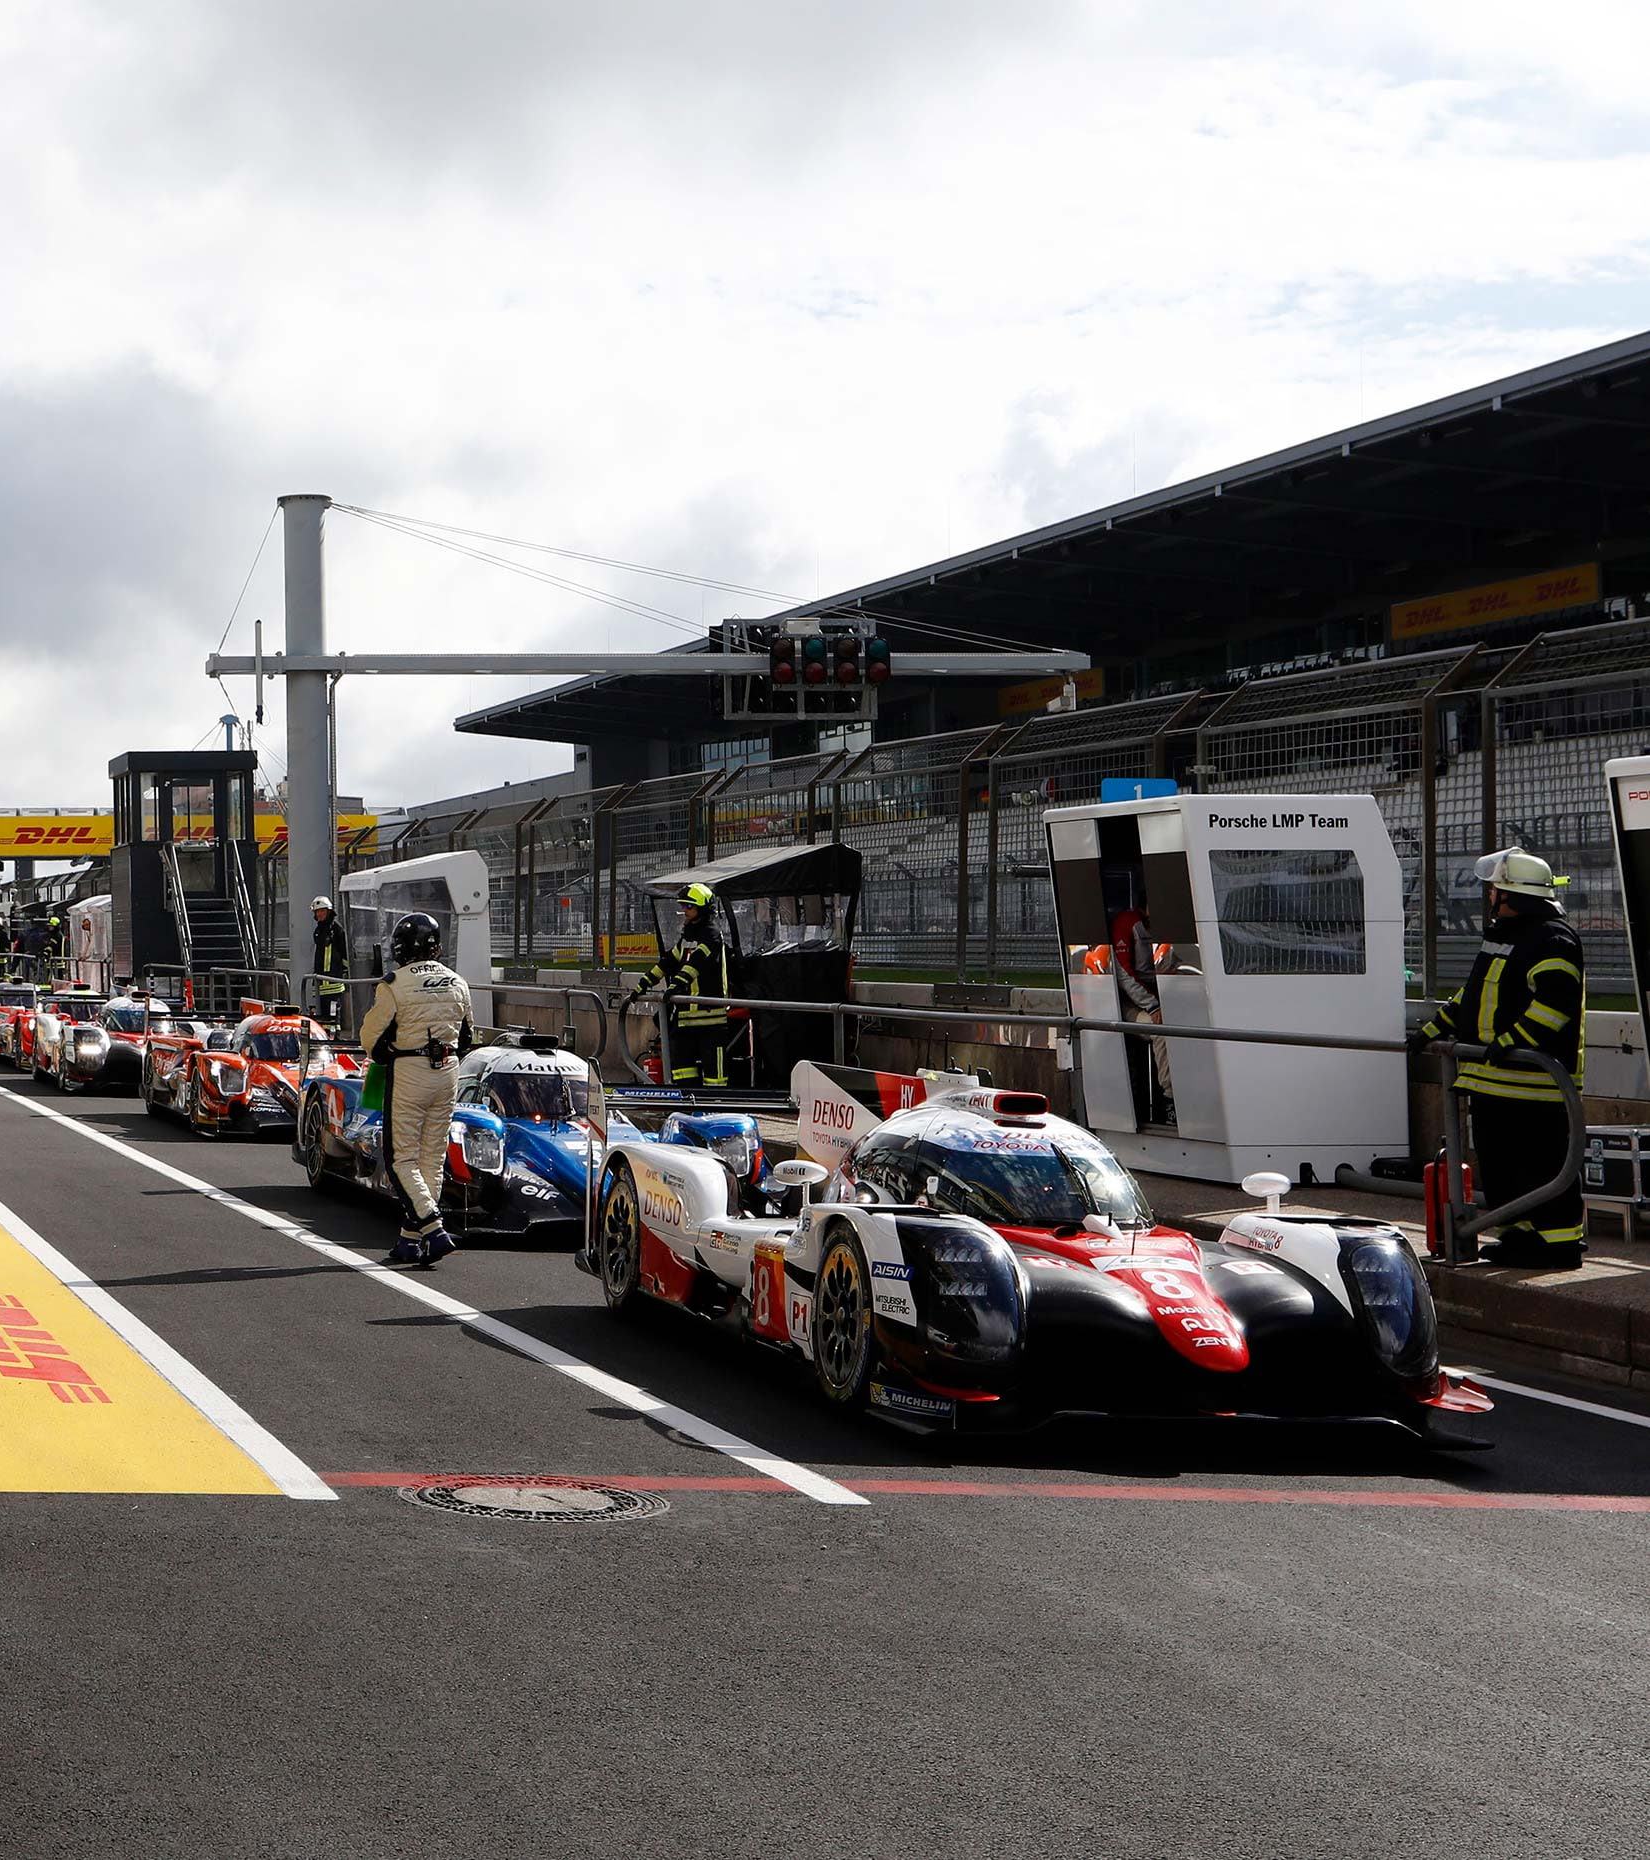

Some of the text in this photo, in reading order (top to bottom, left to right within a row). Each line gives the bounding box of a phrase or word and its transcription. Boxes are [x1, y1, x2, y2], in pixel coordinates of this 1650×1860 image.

[1534, 576, 1582, 601] DHL
[1468, 592, 1513, 615] DHL
[1405, 605, 1447, 628] DHL
[1133, 784, 1143, 799] 1
[1629, 791, 1650, 801] PO
[1209, 814, 1348, 829] Porsche LMP Team
[14, 827, 98, 844] DHL
[624, 1090, 679, 1098] MICHELIN
[901, 1084, 915, 1109] HY
[812, 1100, 855, 1130] DENSO
[812, 1132, 831, 1146] TOYOTA
[972, 1139, 1047, 1151] TOYOTA
[783, 1167, 797, 1176] Mobil
[521, 1185, 560, 1201] elf
[644, 1190, 682, 1226] DENSO
[1275, 1235, 1284, 1249] 8
[873, 1265, 910, 1279] AISIN
[1140, 1270, 1196, 1299] 8
[757, 1266, 769, 1326] 8
[875, 1294, 907, 1306] MITSUBISHI
[793, 1300, 807, 1334] P1
[881, 1304, 910, 1315] ELECTRIC
[1157, 1306, 1207, 1316] Mobil
[891, 1392, 951, 1411] MICHELIN
